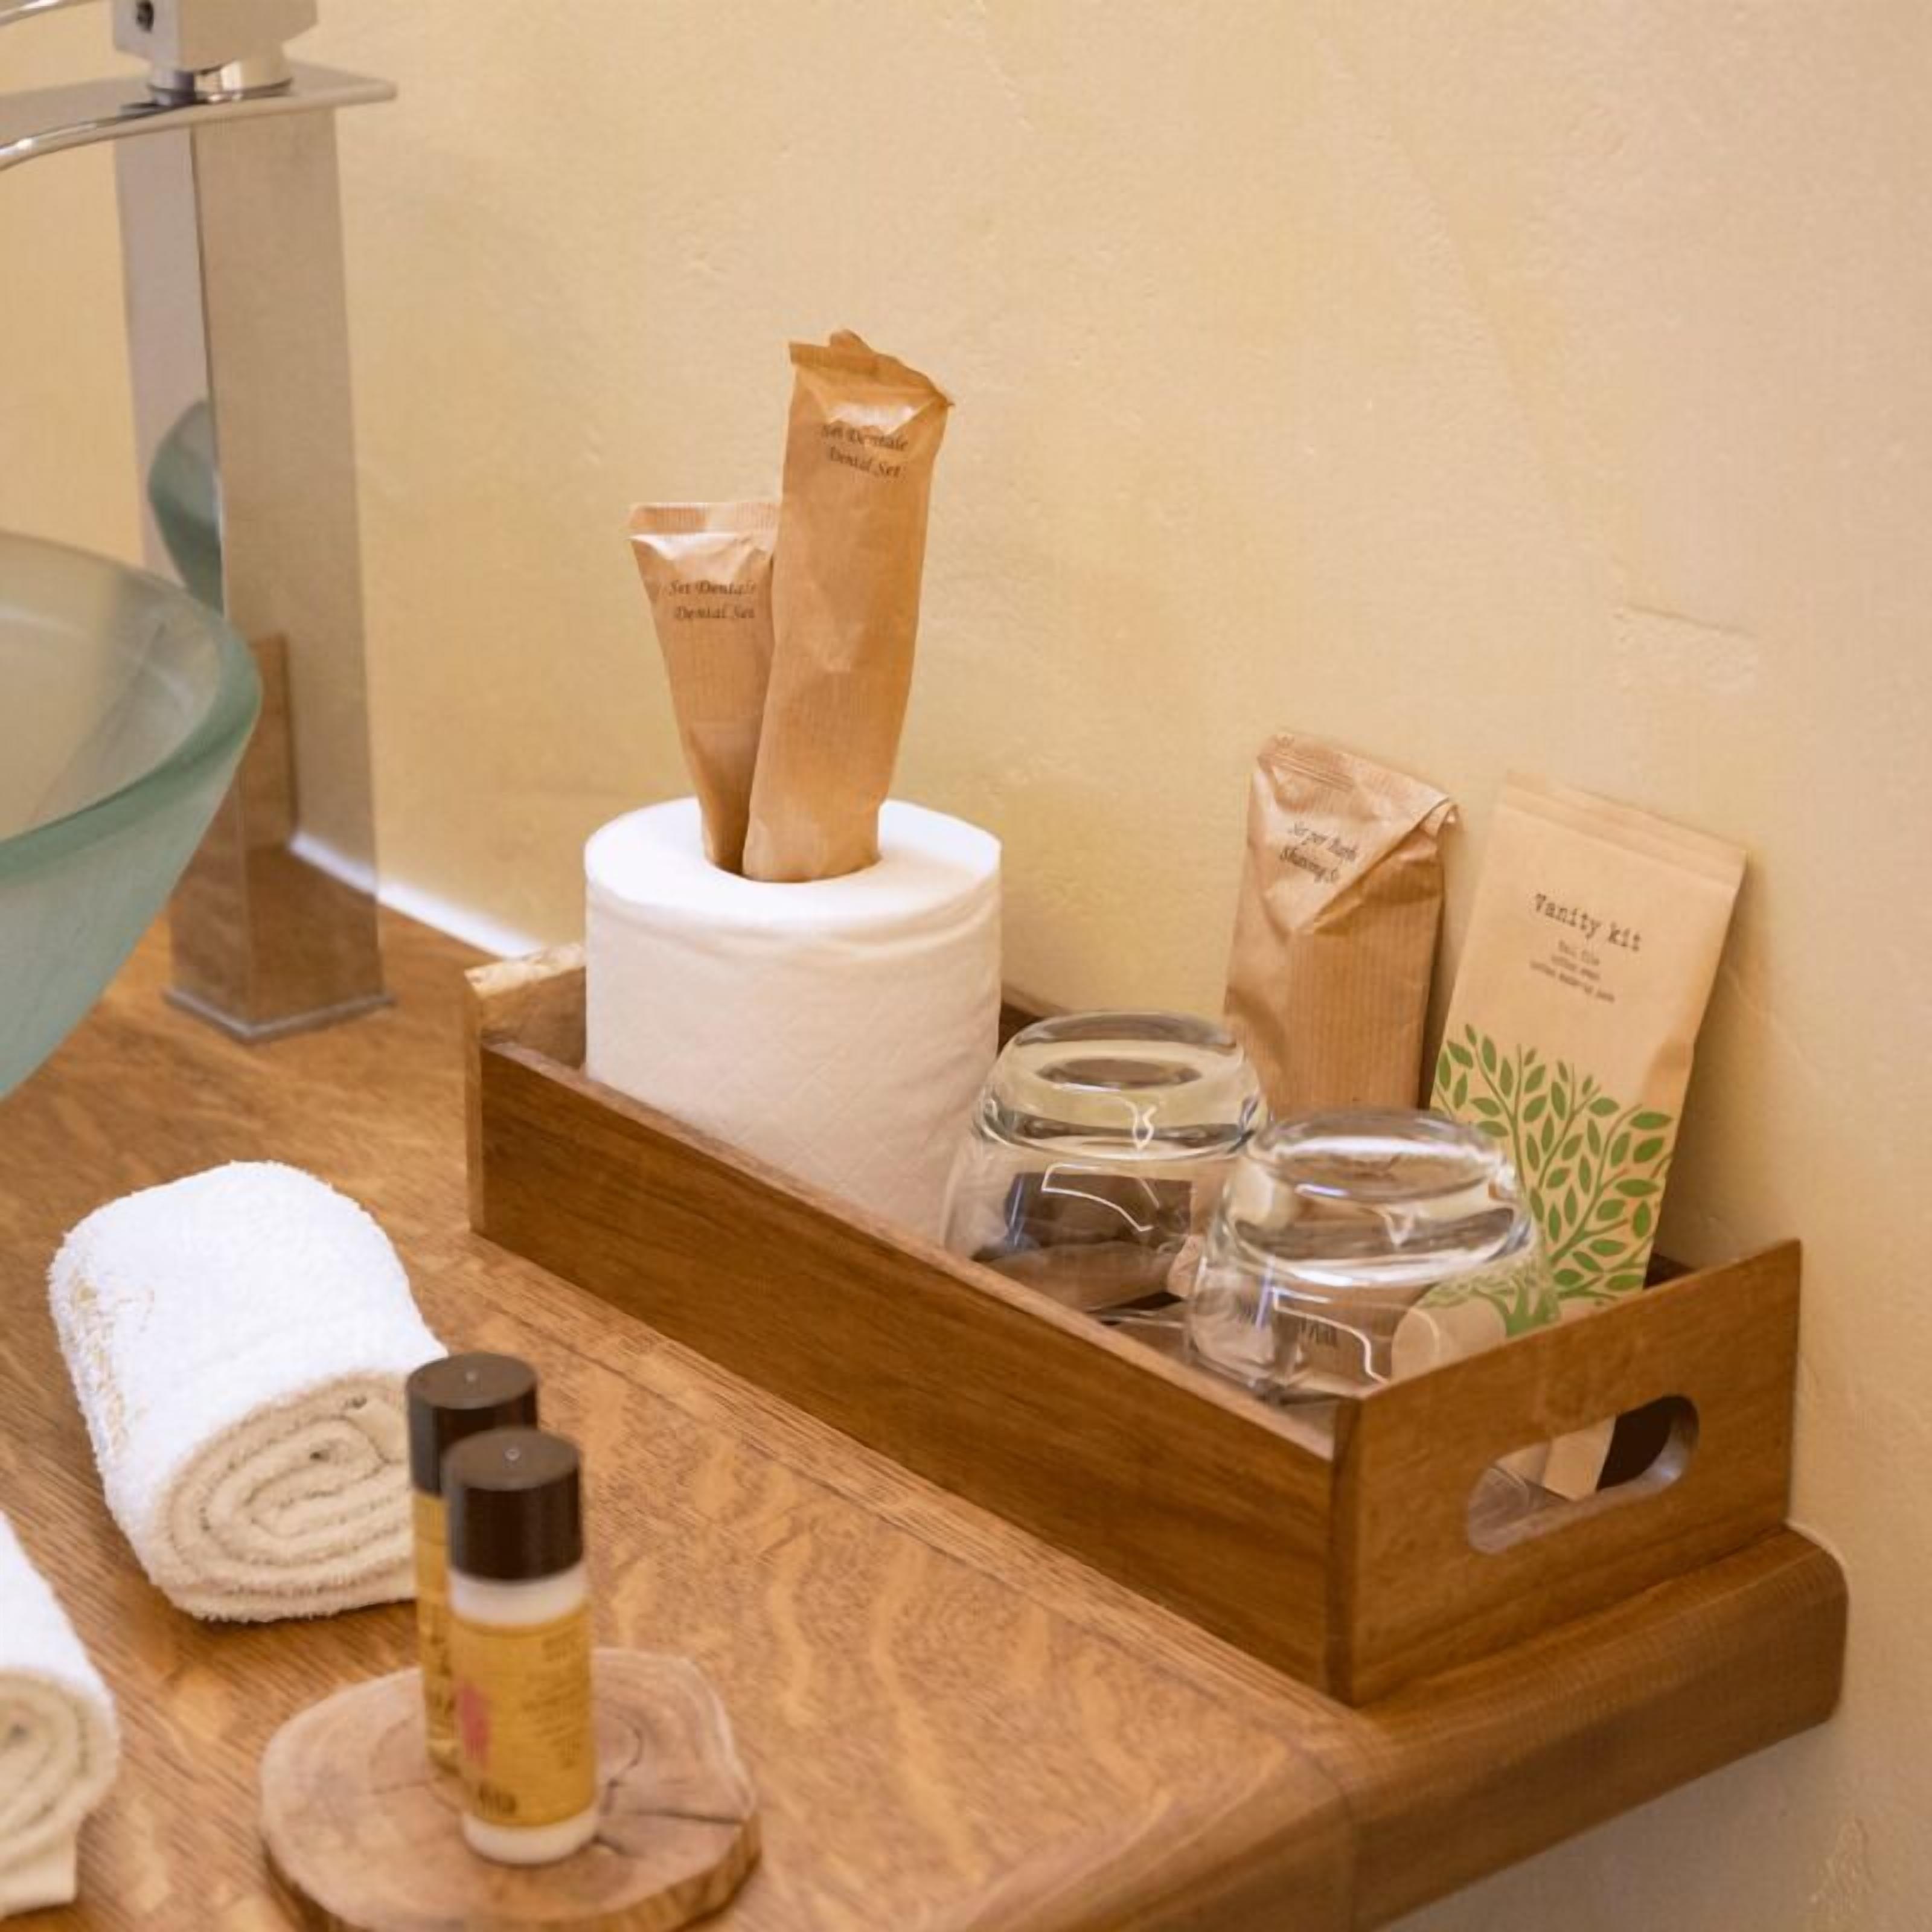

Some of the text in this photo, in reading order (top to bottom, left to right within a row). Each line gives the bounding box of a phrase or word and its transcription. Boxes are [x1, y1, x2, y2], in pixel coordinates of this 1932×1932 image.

[830, 446, 901, 478] Dental Set
[669, 580, 691, 595] Set
[675, 605, 756, 621] Dental Set
[1535, 893, 1641, 952] Vanity kit
